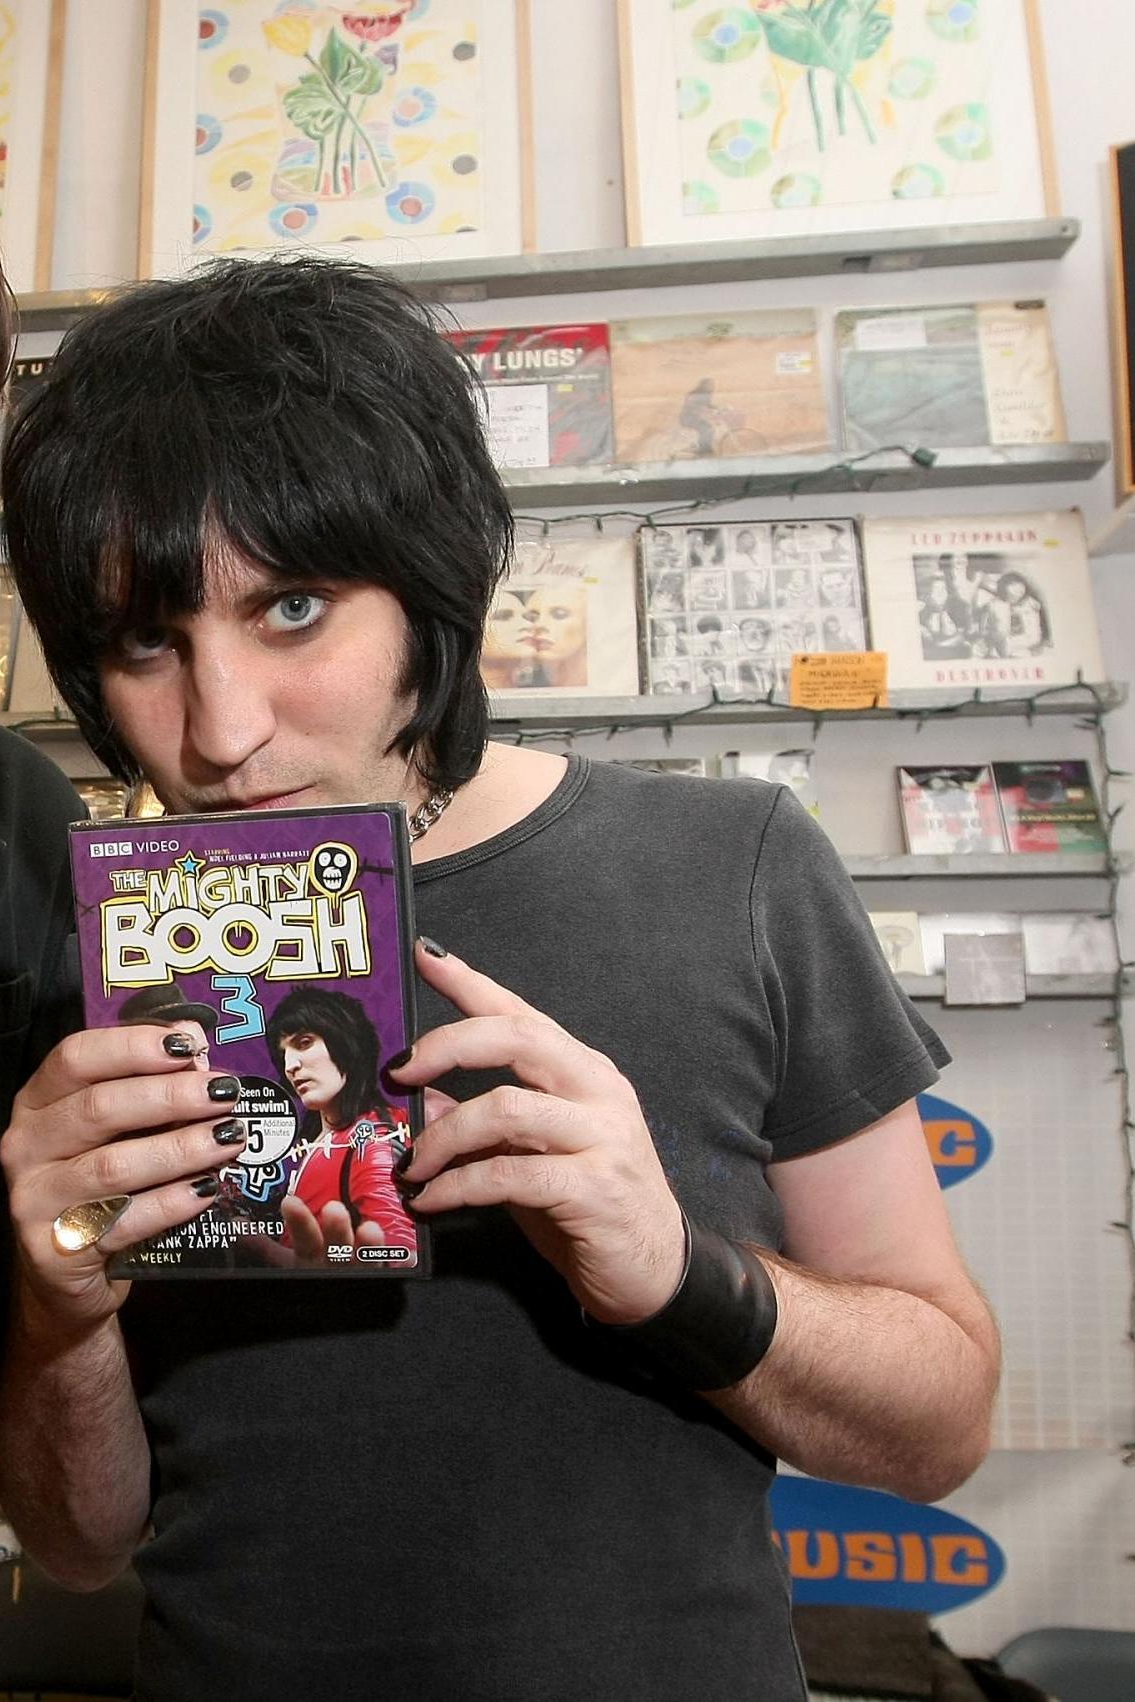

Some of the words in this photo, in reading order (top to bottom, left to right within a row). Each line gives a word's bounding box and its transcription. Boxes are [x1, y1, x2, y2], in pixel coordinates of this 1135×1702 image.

[90, 842, 133, 857] BBC
[136, 840, 180, 853] VIDEO
[109, 869, 146, 892] THE
[147, 862, 310, 915] MIGHTY
[101, 892, 372, 987] BOOSH
[211, 974, 266, 1044] 3
[240, 1087, 261, 1098] Seen
[263, 1086, 275, 1097] On
[264, 1129, 290, 1137] Minutes
[202, 1221, 284, 1236] ENGINEERED
[188, 1235, 237, 1249] ZAPPA"
[327, 1245, 354, 1254] DVD
[362, 1250, 368, 1258] 2
[368, 1250, 388, 1258] DISC
[140, 1252, 182, 1264] WEEKLY
[771, 1530, 989, 1587] USIC
